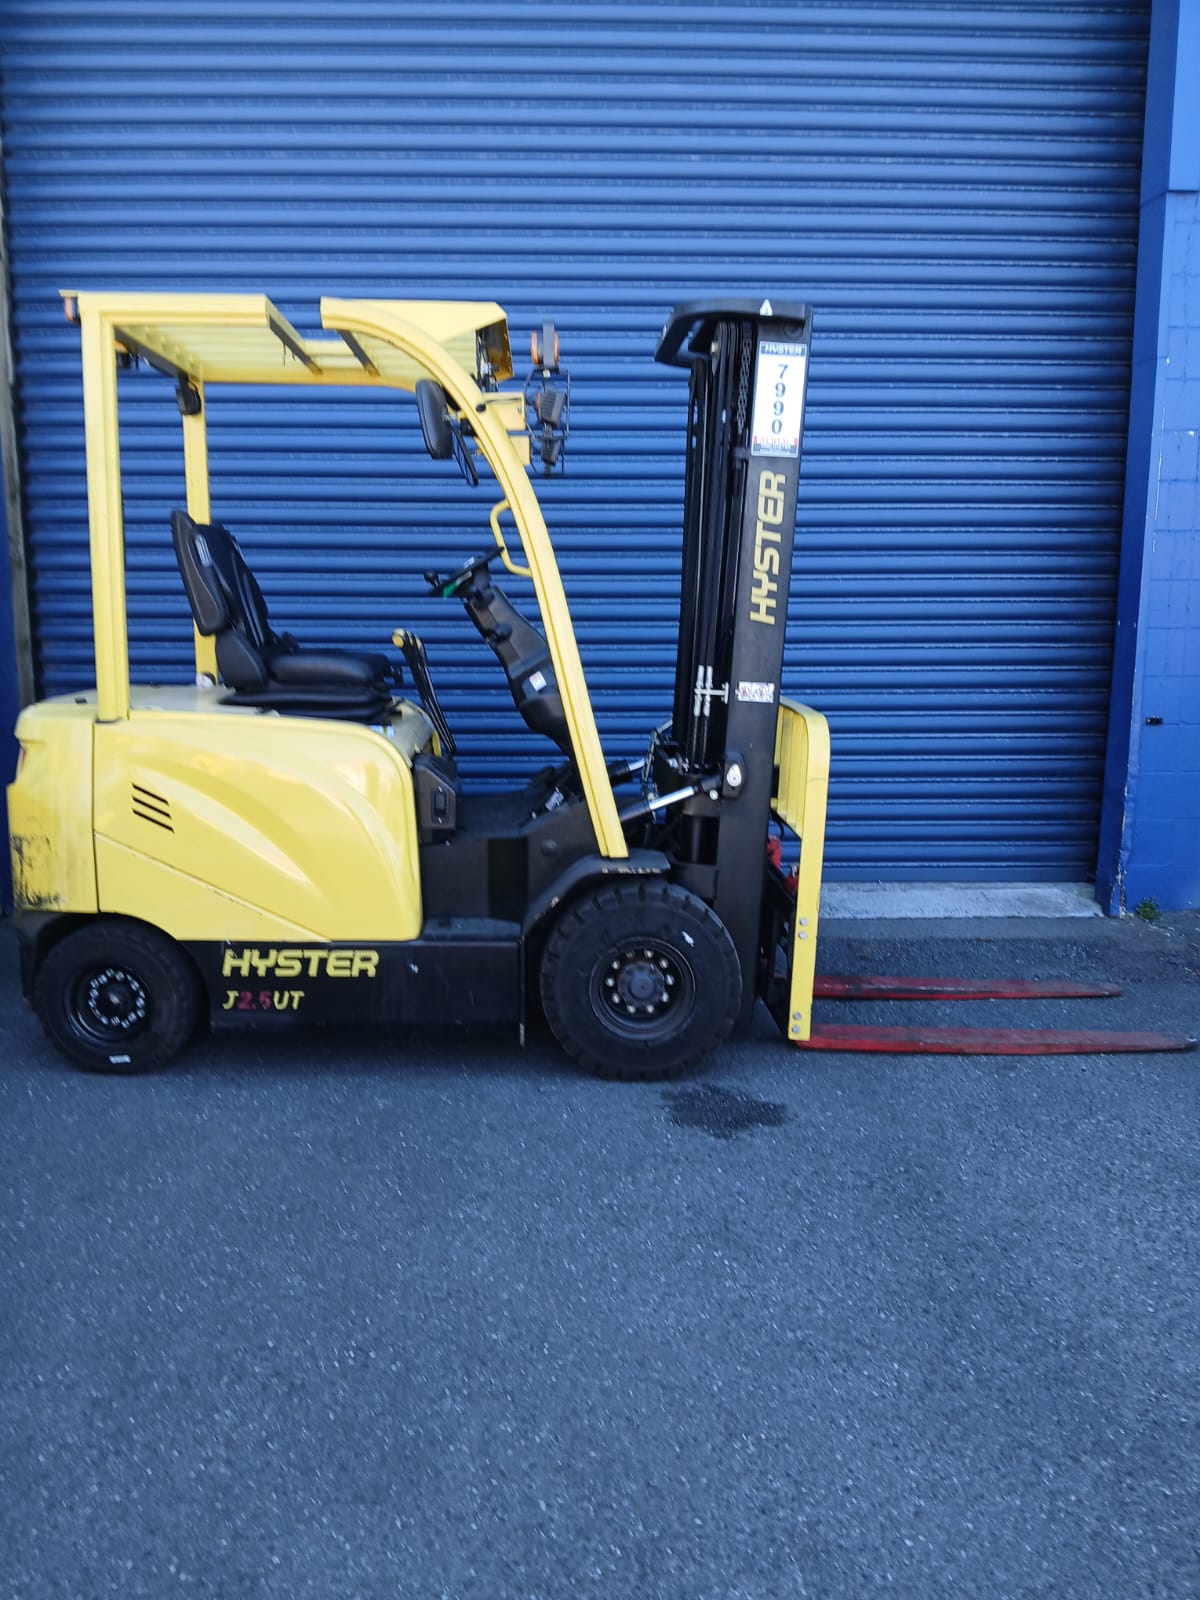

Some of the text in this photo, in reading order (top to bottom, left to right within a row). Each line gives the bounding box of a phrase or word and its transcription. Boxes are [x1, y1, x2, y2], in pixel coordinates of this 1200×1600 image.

[771, 363, 789, 434] 7990
[750, 470, 786, 625] HYSTER
[222, 949, 379, 977] HYSTER
